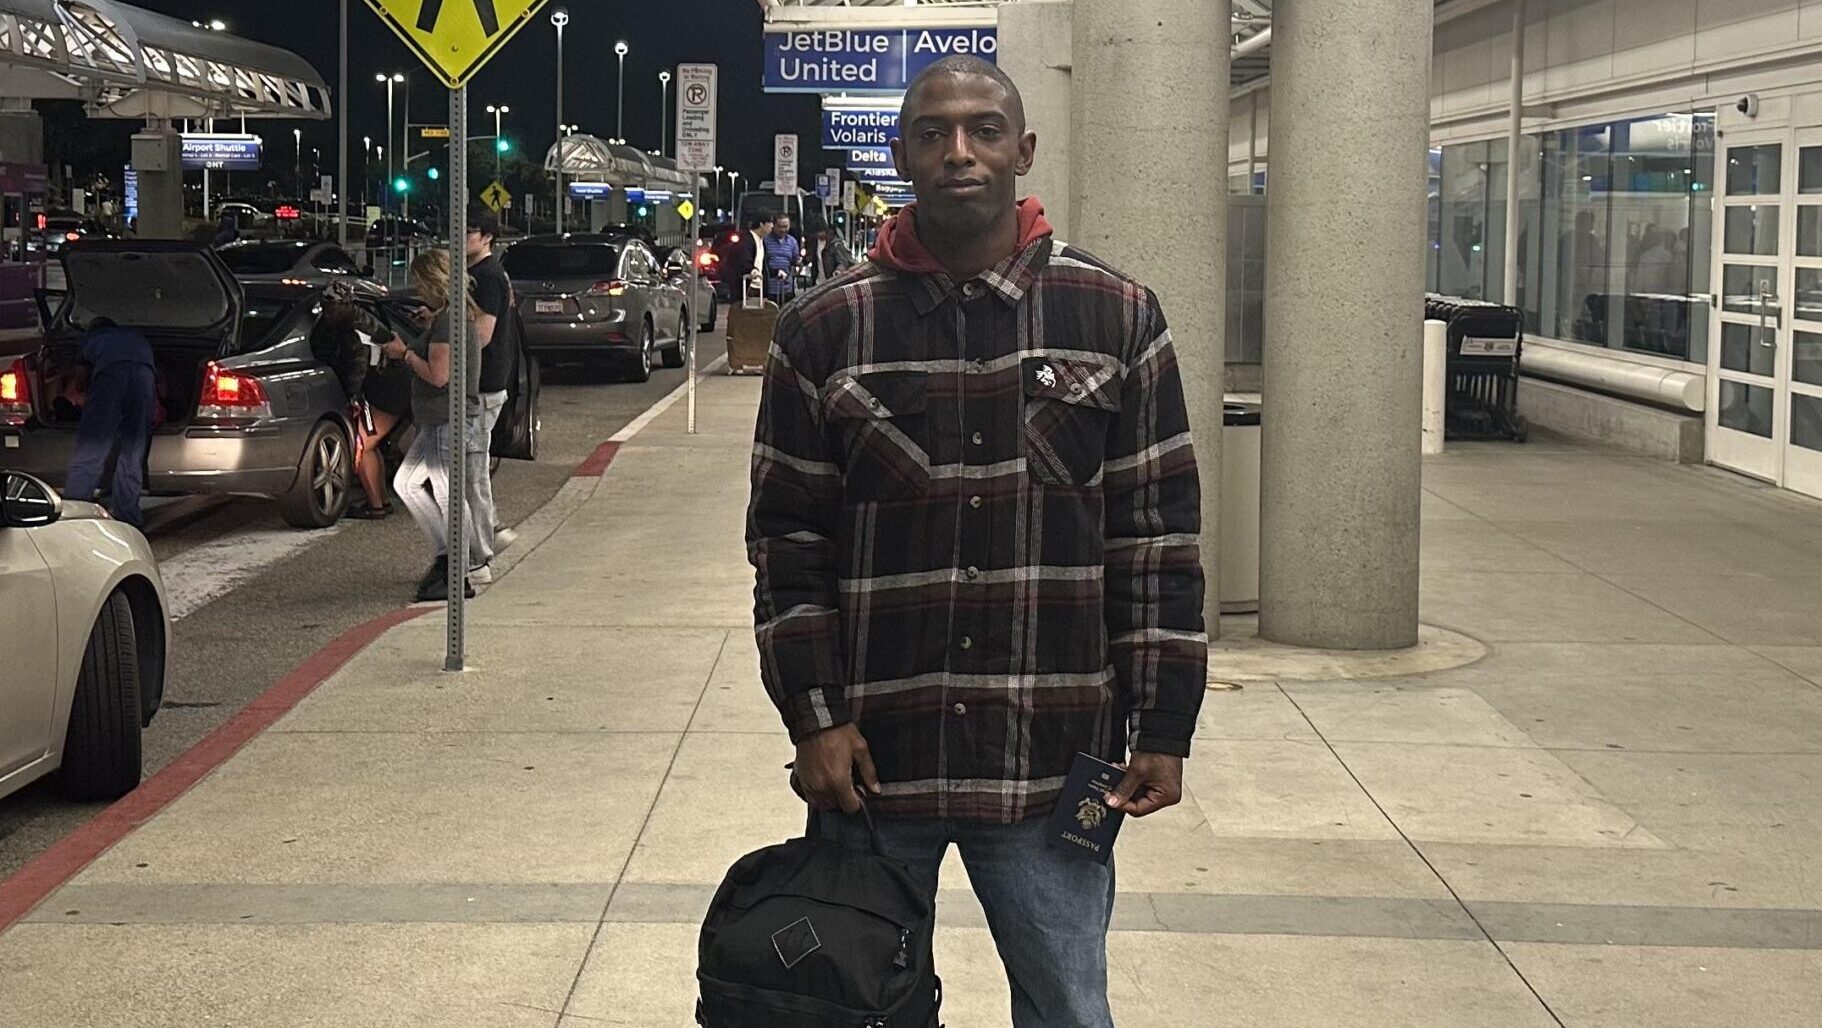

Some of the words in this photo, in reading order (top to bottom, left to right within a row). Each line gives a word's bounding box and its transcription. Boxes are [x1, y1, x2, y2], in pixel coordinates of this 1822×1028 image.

[778, 30, 889, 53] JetBlue
[913, 29, 997, 53] Avelo
[779, 57, 877, 82] United
[831, 112, 898, 126] Frontier
[830, 128, 887, 143] Volaris
[182, 143, 213, 153] Airport
[214, 143, 247, 152] Shuttle
[851, 150, 887, 162] Delta
[1061, 831, 1100, 852] PASSPORT
